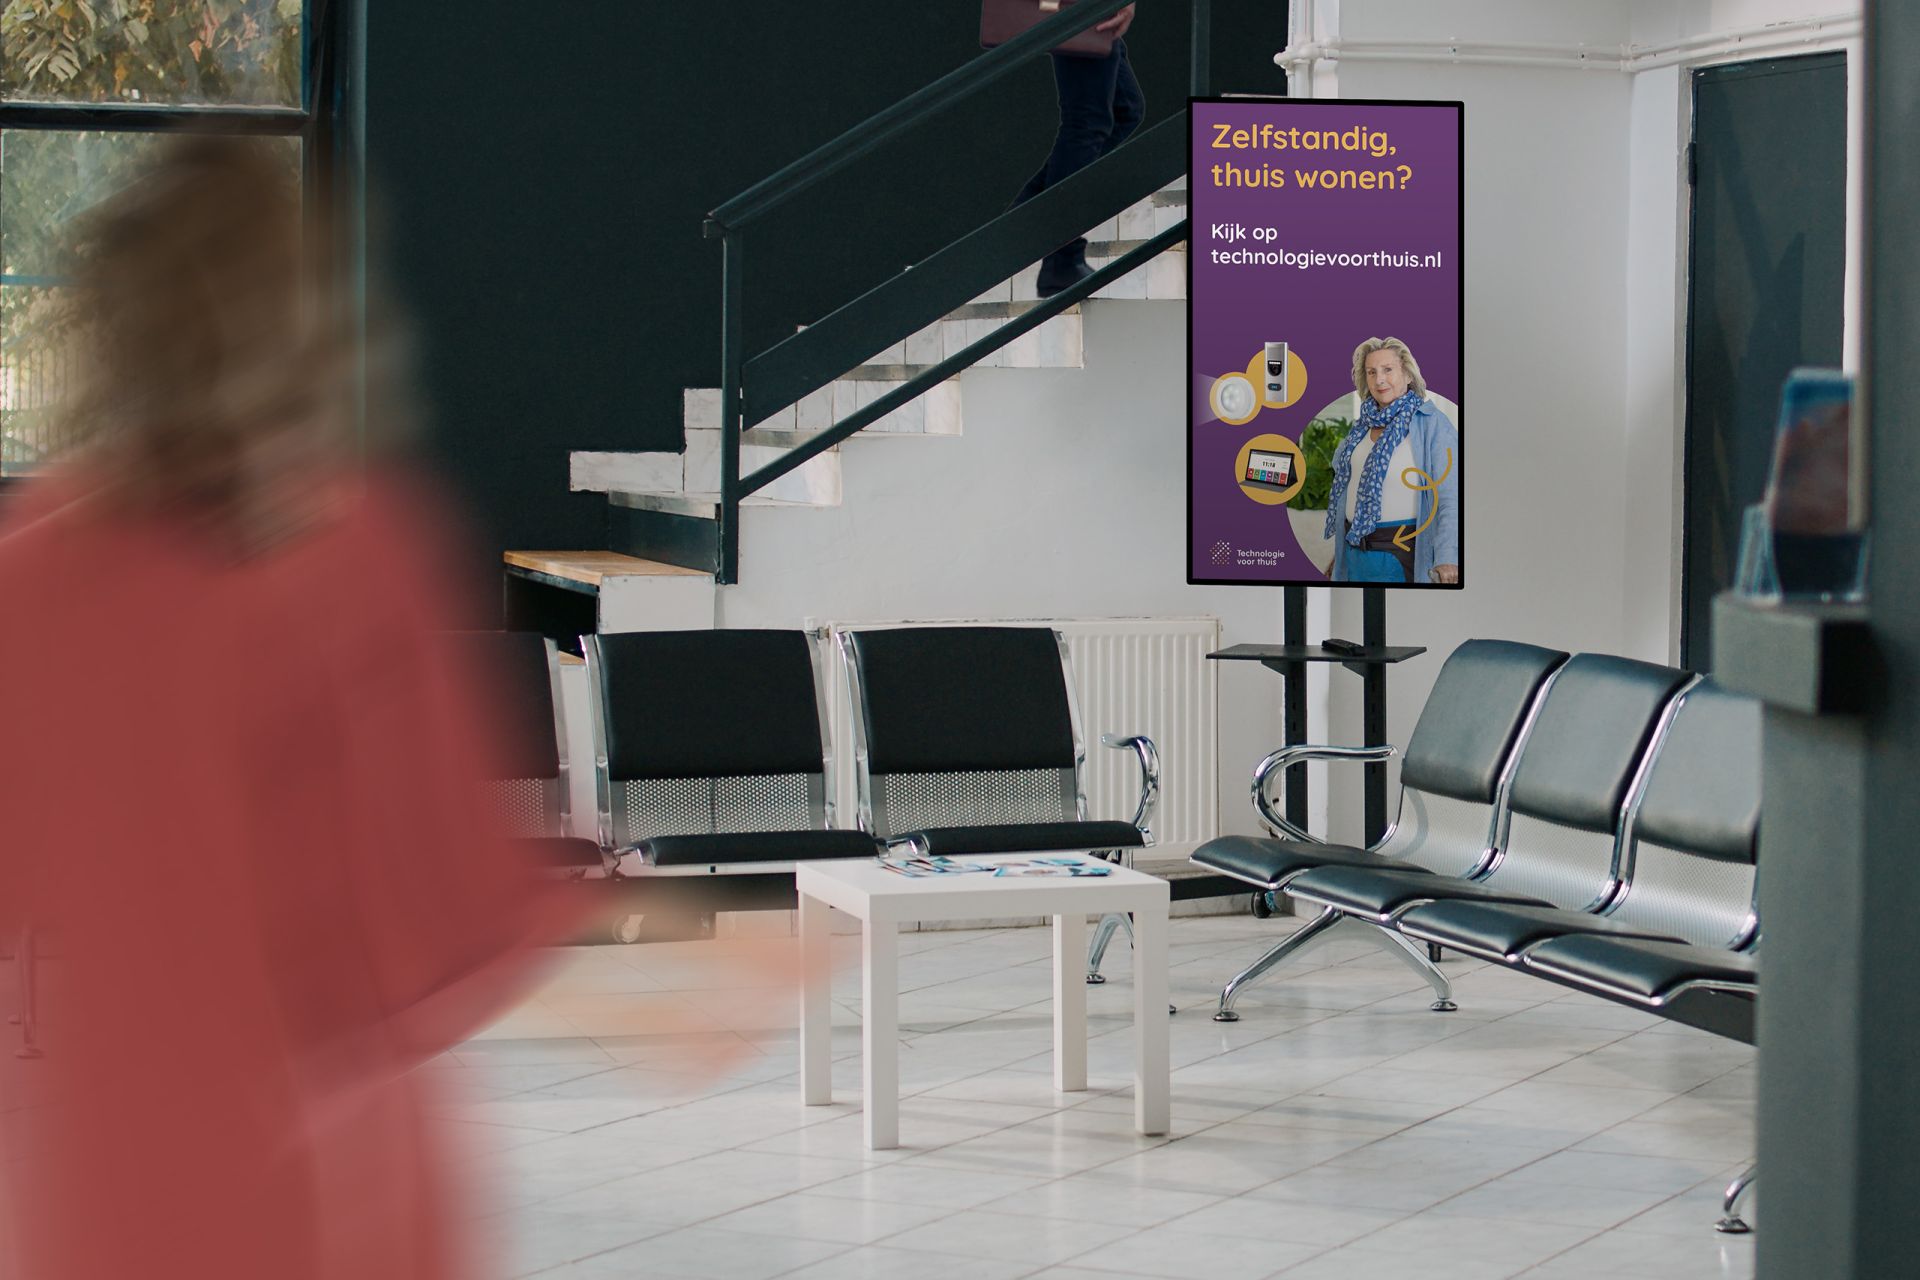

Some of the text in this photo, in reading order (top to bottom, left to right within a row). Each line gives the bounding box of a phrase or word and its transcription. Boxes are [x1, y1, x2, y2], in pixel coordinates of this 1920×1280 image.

[1211, 124, 1397, 157] Zelfstandig,
[1211, 162, 1413, 190] thuis wonen?
[1211, 223, 1278, 244] Kijk op
[1211, 248, 1442, 269] technologievoorthuis.nl
[1237, 549, 1285, 559] Technologie
[1257, 558, 1277, 566] thuis
